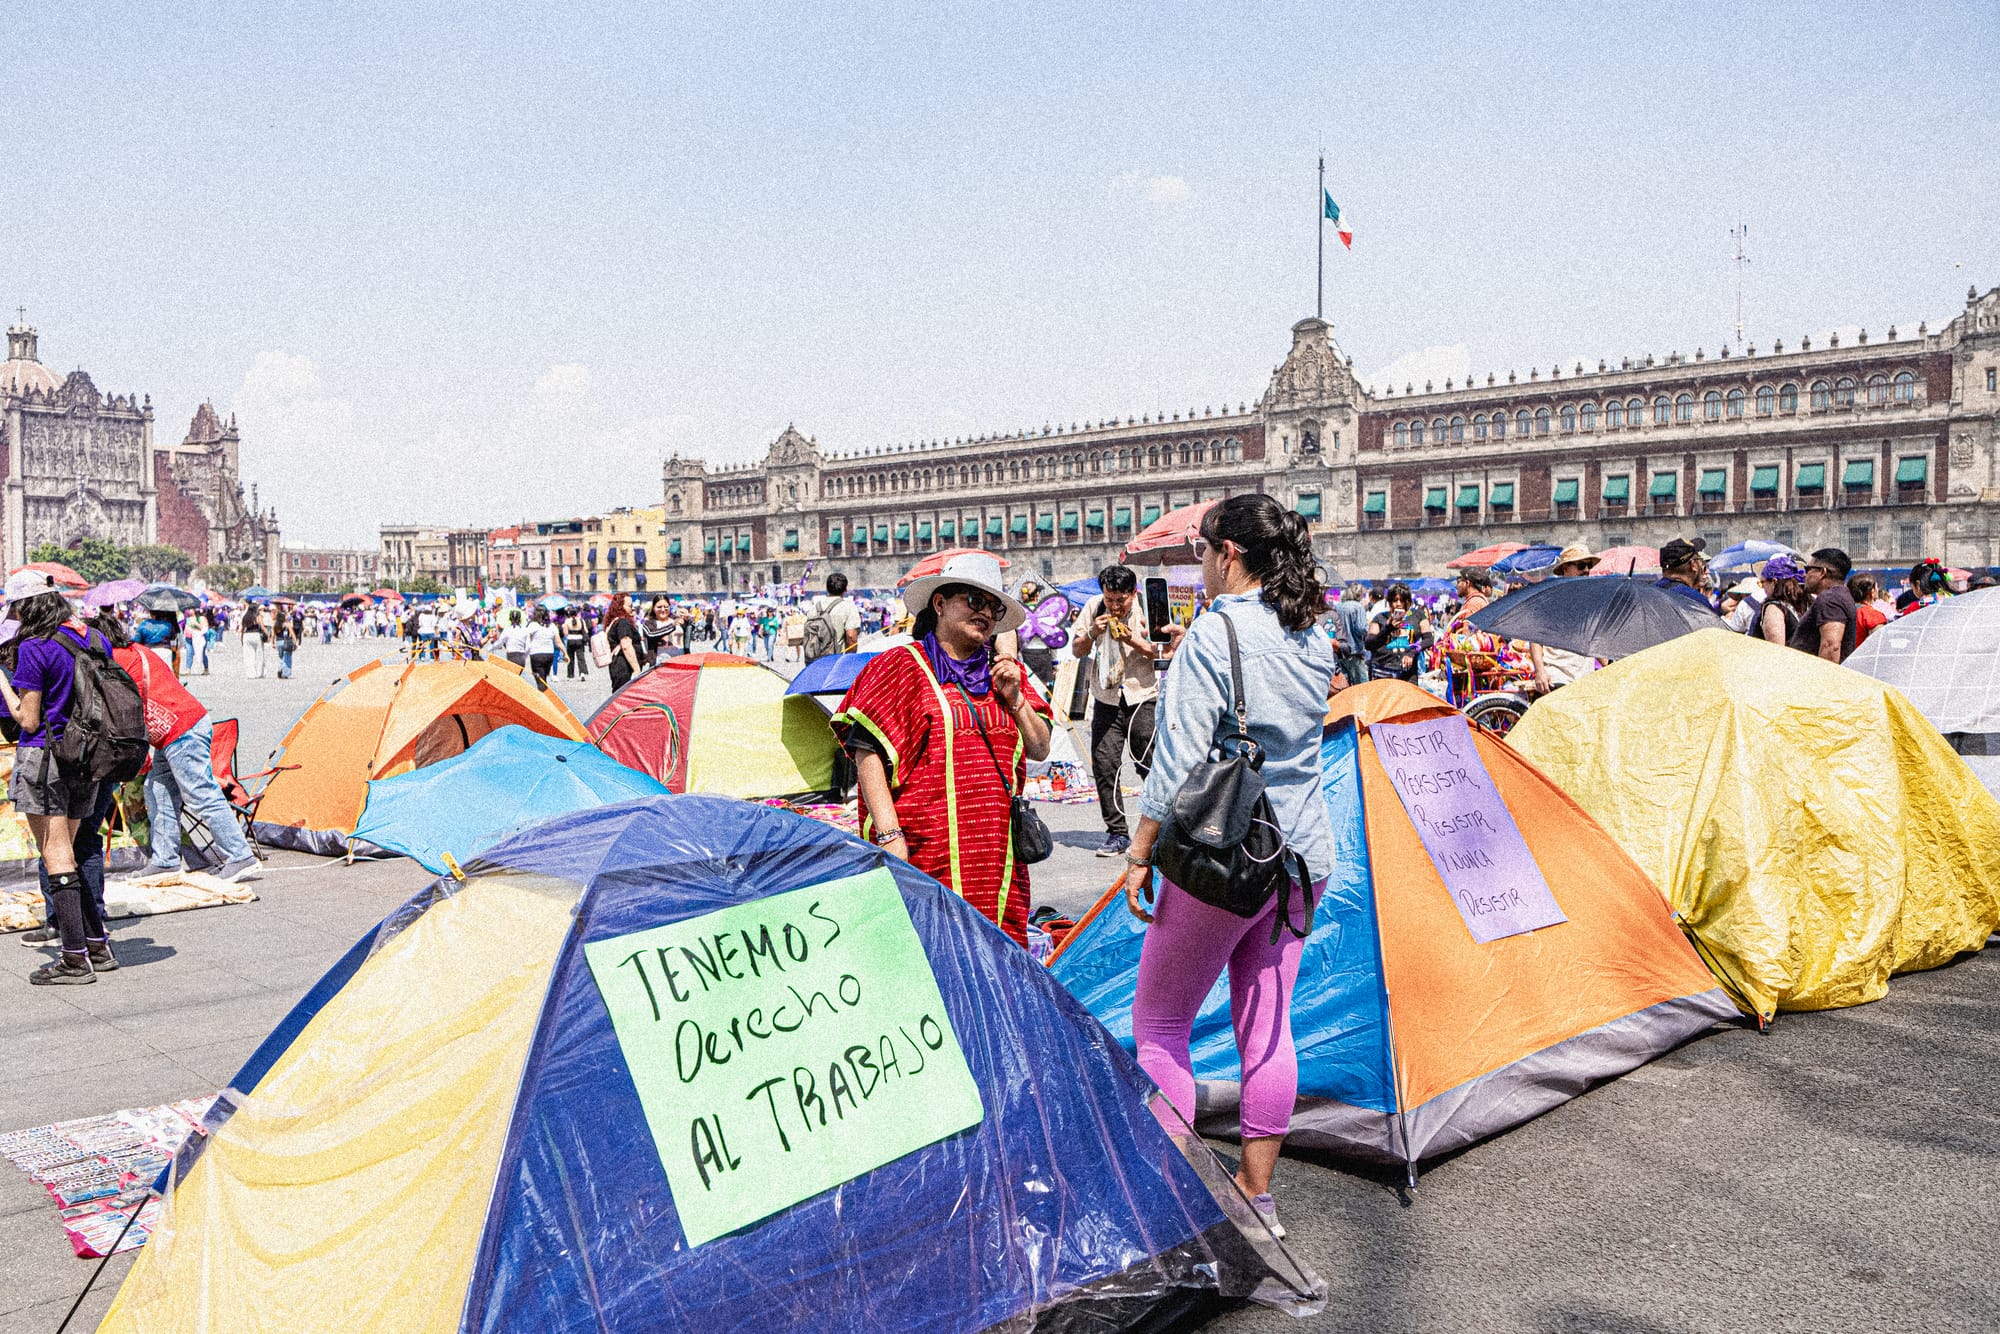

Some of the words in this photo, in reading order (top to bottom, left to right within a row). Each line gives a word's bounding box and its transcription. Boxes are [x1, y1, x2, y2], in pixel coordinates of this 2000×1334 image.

[1380, 727, 1459, 759] INSISTIR,
[1395, 767, 1480, 796] PERSISTIR,
[1413, 804, 1496, 837] RESISTIR,
[1438, 851, 1450, 873] Y
[1451, 849, 1494, 871] NUNCA
[1458, 888, 1528, 917] DESISTIR
[617, 901, 840, 1021] TENEMOS
[675, 973, 861, 1083] Derecho
[690, 1113, 742, 1191] AL
[746, 1014, 943, 1152] TRABAJO
